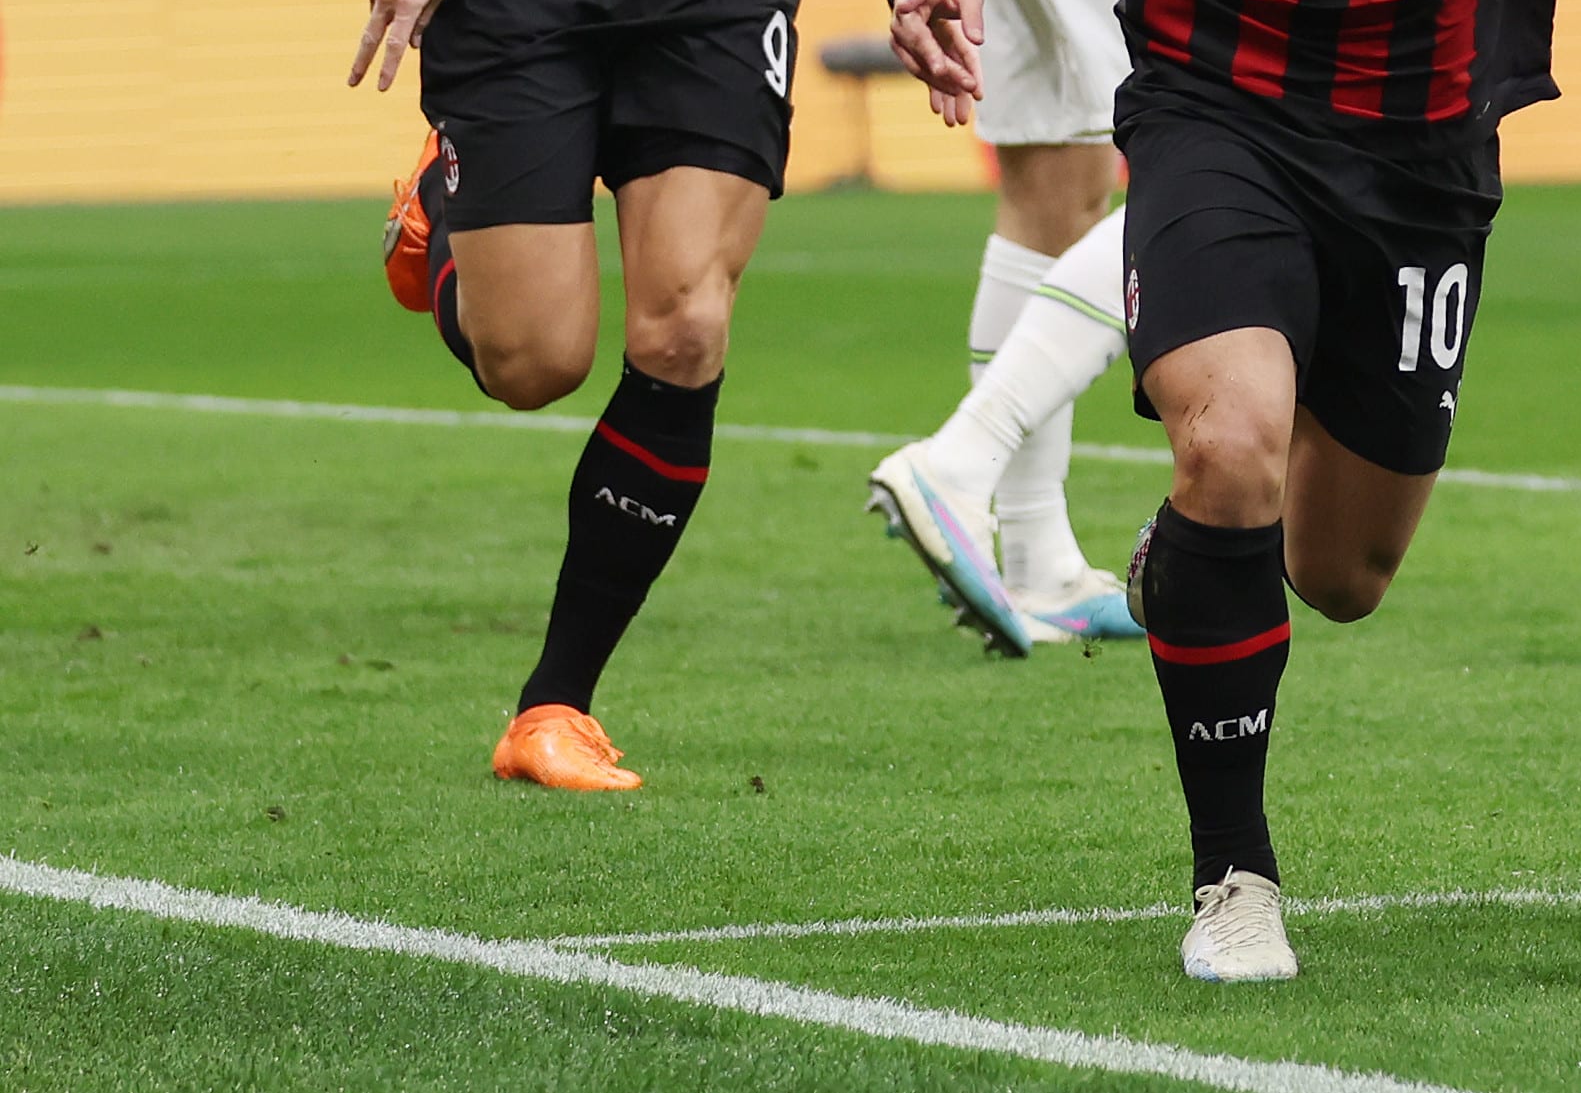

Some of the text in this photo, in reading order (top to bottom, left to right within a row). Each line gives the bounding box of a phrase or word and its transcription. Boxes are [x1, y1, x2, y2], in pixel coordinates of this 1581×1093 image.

[762, 10, 788, 98] 9
[1398, 263, 1468, 372] 10
[594, 487, 678, 527] ACM
[1188, 708, 1269, 741] ACM
